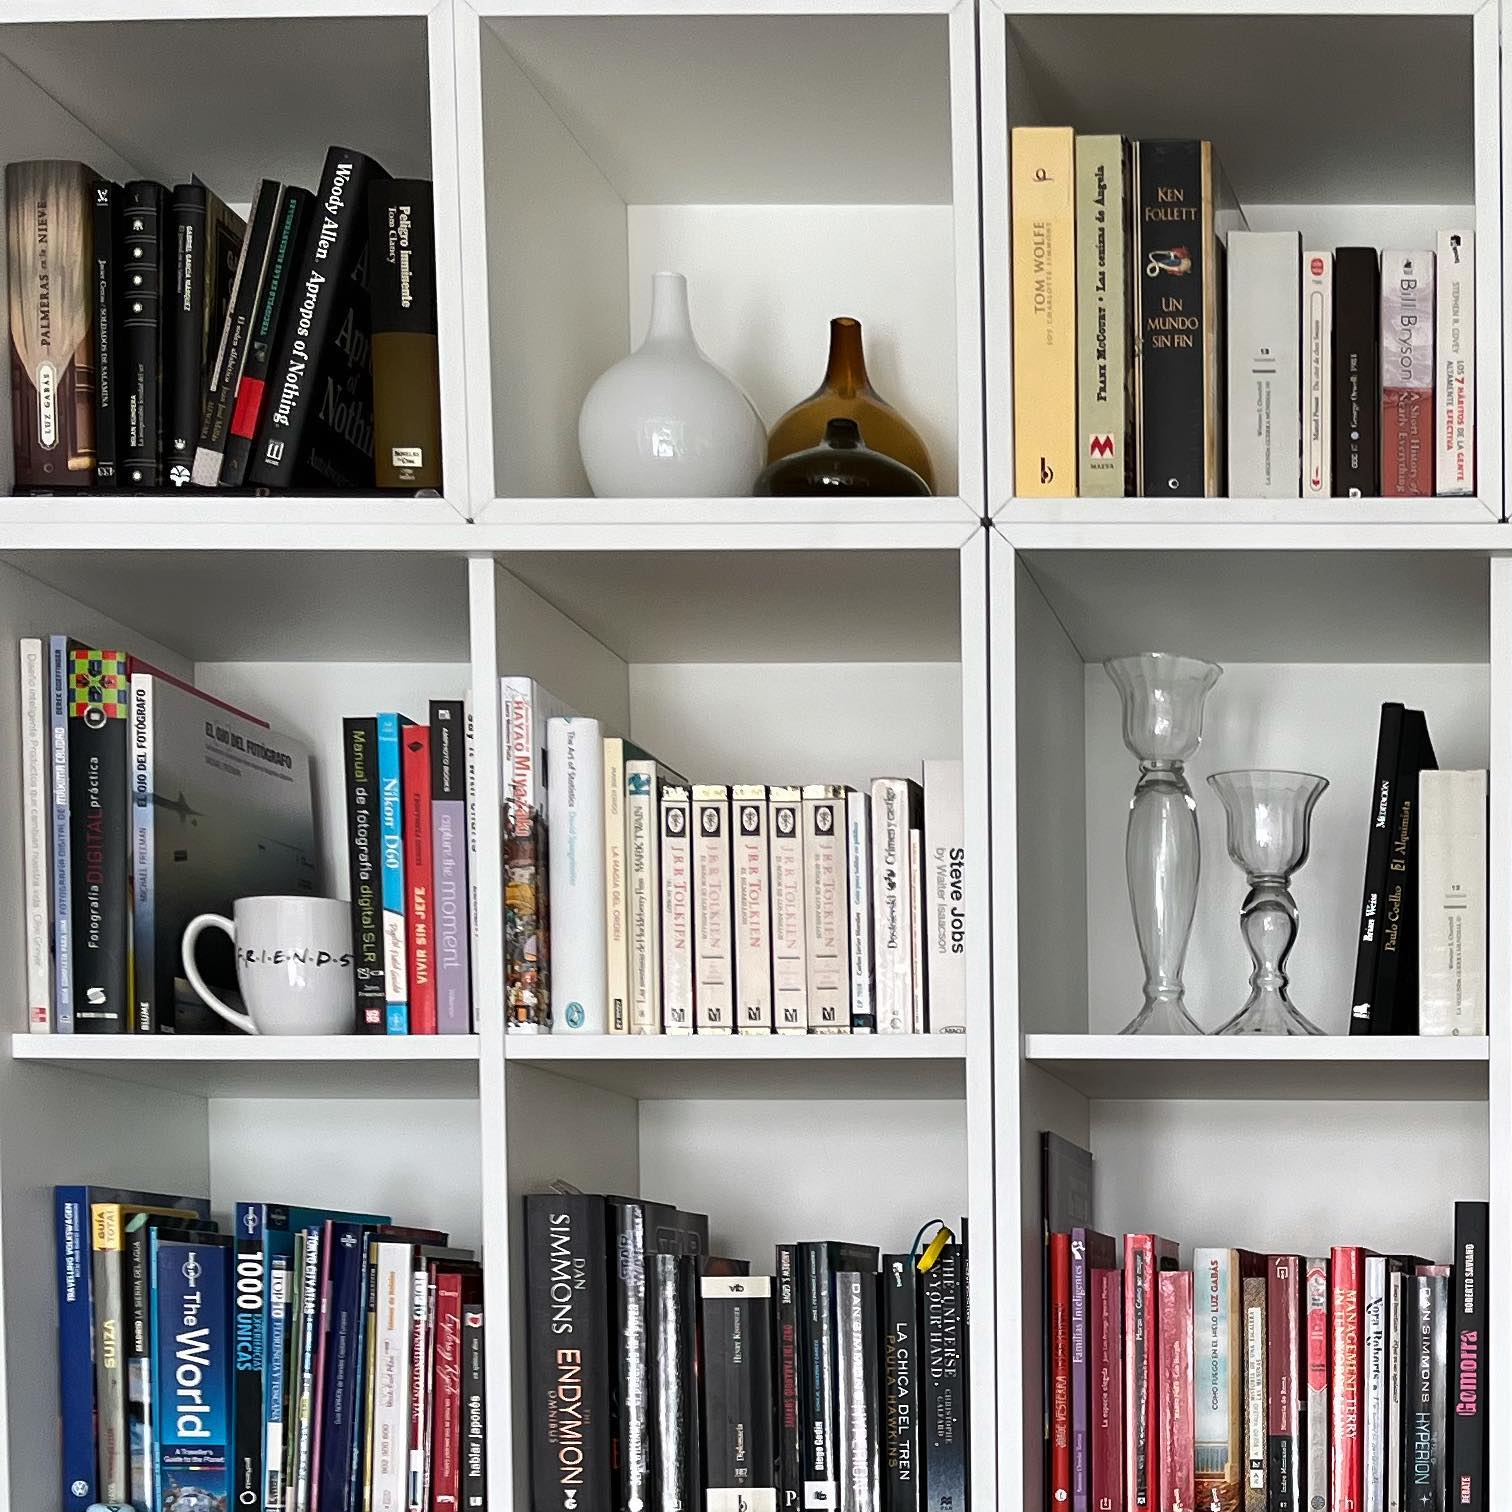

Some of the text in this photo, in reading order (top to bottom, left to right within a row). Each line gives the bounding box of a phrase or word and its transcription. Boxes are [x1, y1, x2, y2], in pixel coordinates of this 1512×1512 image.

[324, 163, 352, 215] Woody
[1144, 207, 1198, 223] FOLLETT
[1157, 186, 1185, 203] KEN
[296, 270, 326, 337] Apropos
[1147, 317, 1200, 331] MUNDO
[1398, 278, 1418, 382] Bill Bryson
[273, 360, 306, 426] Nothing
[291, 341, 308, 359] of
[133, 689, 149, 808] EL OJO DEL FOTÓGRAFO
[352, 729, 378, 962] Manual de fotografía digital SLR
[382, 776, 400, 869] Nikon D60
[936, 847, 948, 953] by Walter Isaacson
[949, 847, 965, 953] Steve Jobs
[1383, 800, 1411, 952] Paulo Coelho El Alquimista
[237, 1251, 264, 1309] 1000
[549, 1213, 571, 1334] SIMMONS
[572, 1257, 585, 1290] DAN
[1070, 1264, 1085, 1364] Familias Inteligentes
[1463, 1243, 1475, 1313] ROBERTO SAVIANO
[175, 1291, 211, 1437] The World
[885, 1334, 898, 1467] PAULA HAWKINS
[1455, 1330, 1478, 1416] Gomorra
[468, 1395, 484, 1478] hablar japonés
[556, 1348, 583, 1484] ENDYMION
[1414, 1412, 1429, 1485] HYPERION
